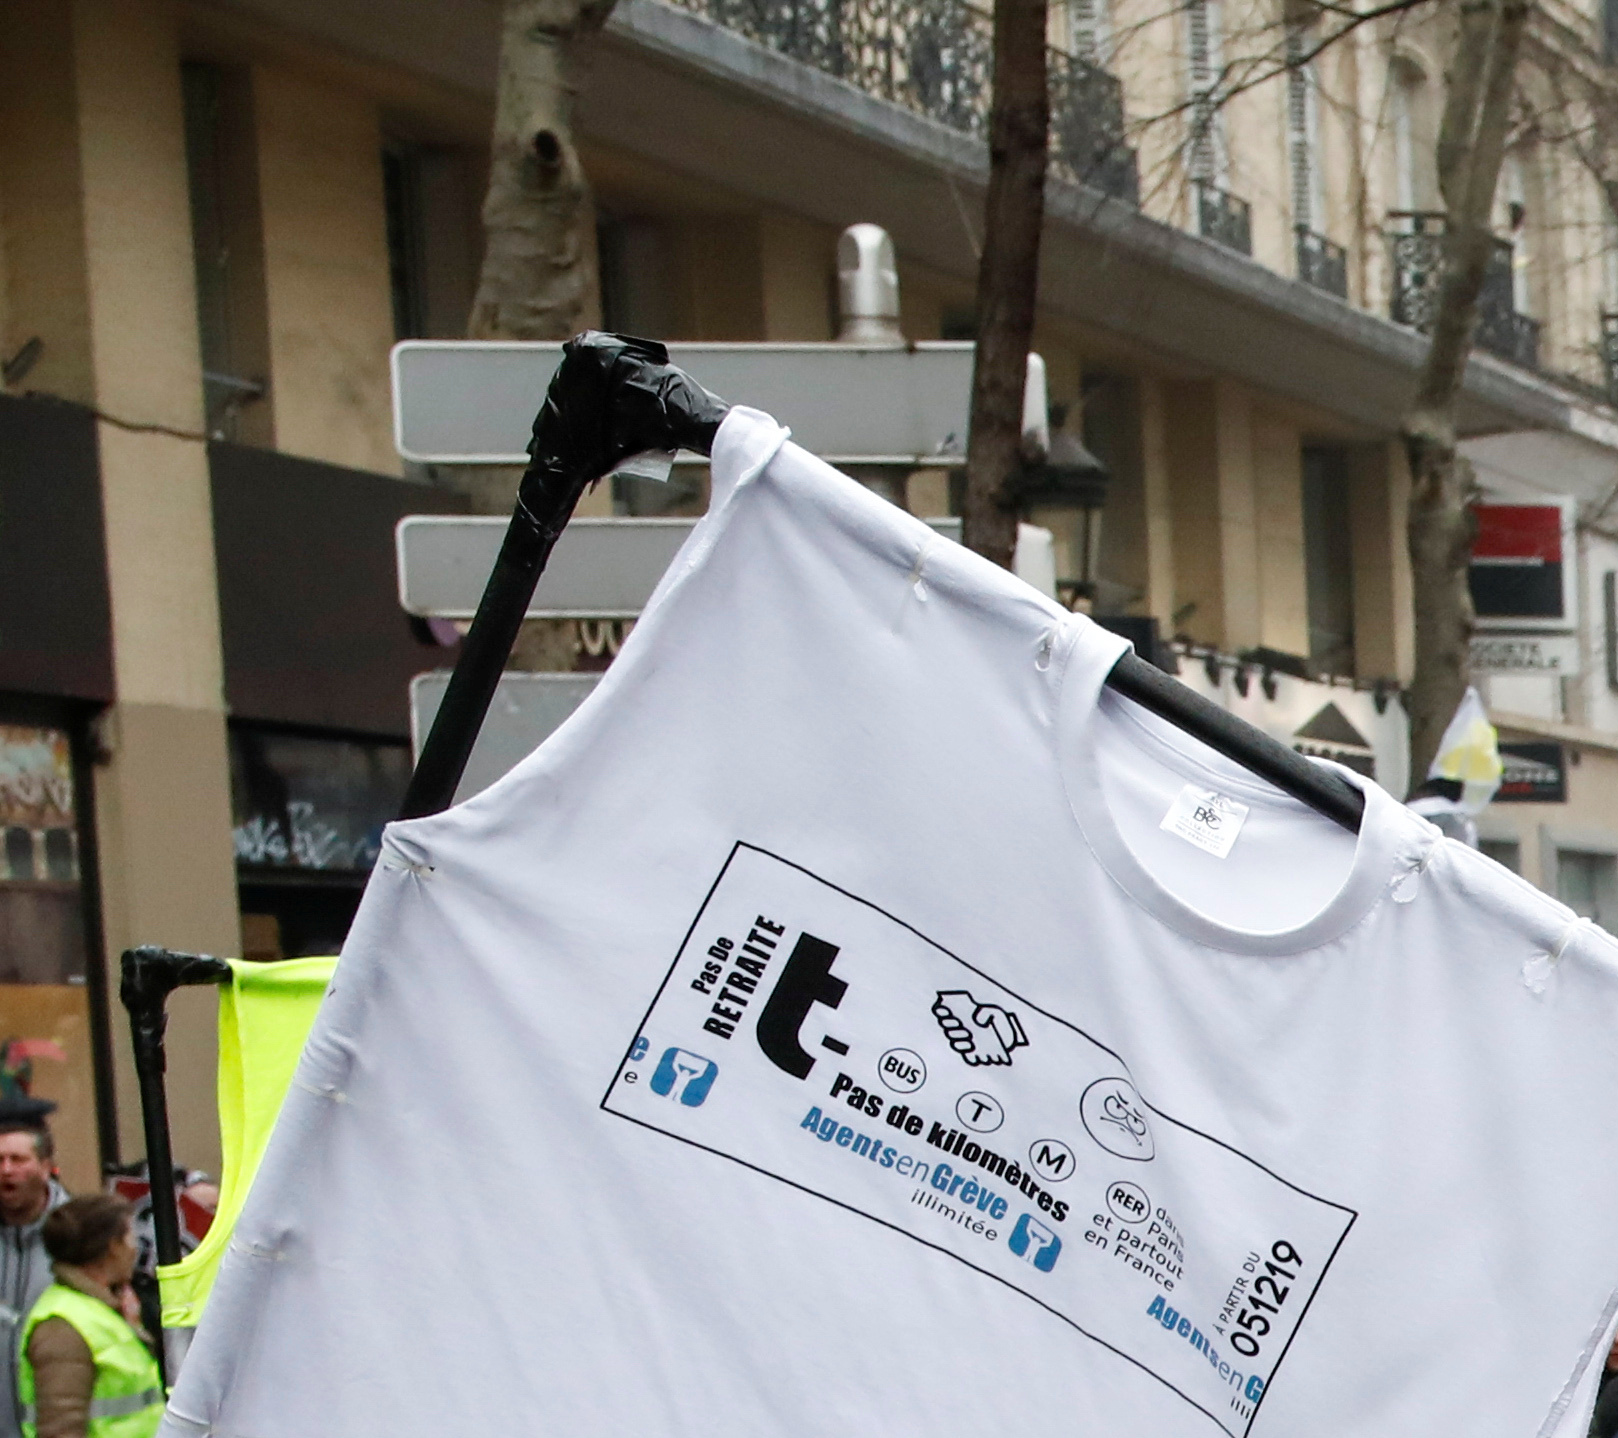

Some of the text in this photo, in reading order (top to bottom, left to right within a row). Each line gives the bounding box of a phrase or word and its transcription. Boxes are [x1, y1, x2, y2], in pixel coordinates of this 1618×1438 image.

[690, 936, 735, 995] Pas De
[703, 914, 786, 1040] RETRAITE
[883, 1055, 921, 1085] BUS
[971, 1098, 993, 1123] T
[829, 1072, 1070, 1223] Pas de kilomètres
[1036, 1145, 1067, 1174] M
[911, 1188, 998, 1242] illimitée
[1112, 1188, 1145, 1216] RER
[1084, 1229, 1175, 1292] en France
[1093, 1213, 1184, 1280] et partout
[1147, 1222, 1184, 1263] Paris
[1220, 1277, 1249, 1322] PARTIR
[1243, 1251, 1261, 1273] DU
[1230, 1239, 1303, 1357] 051219
